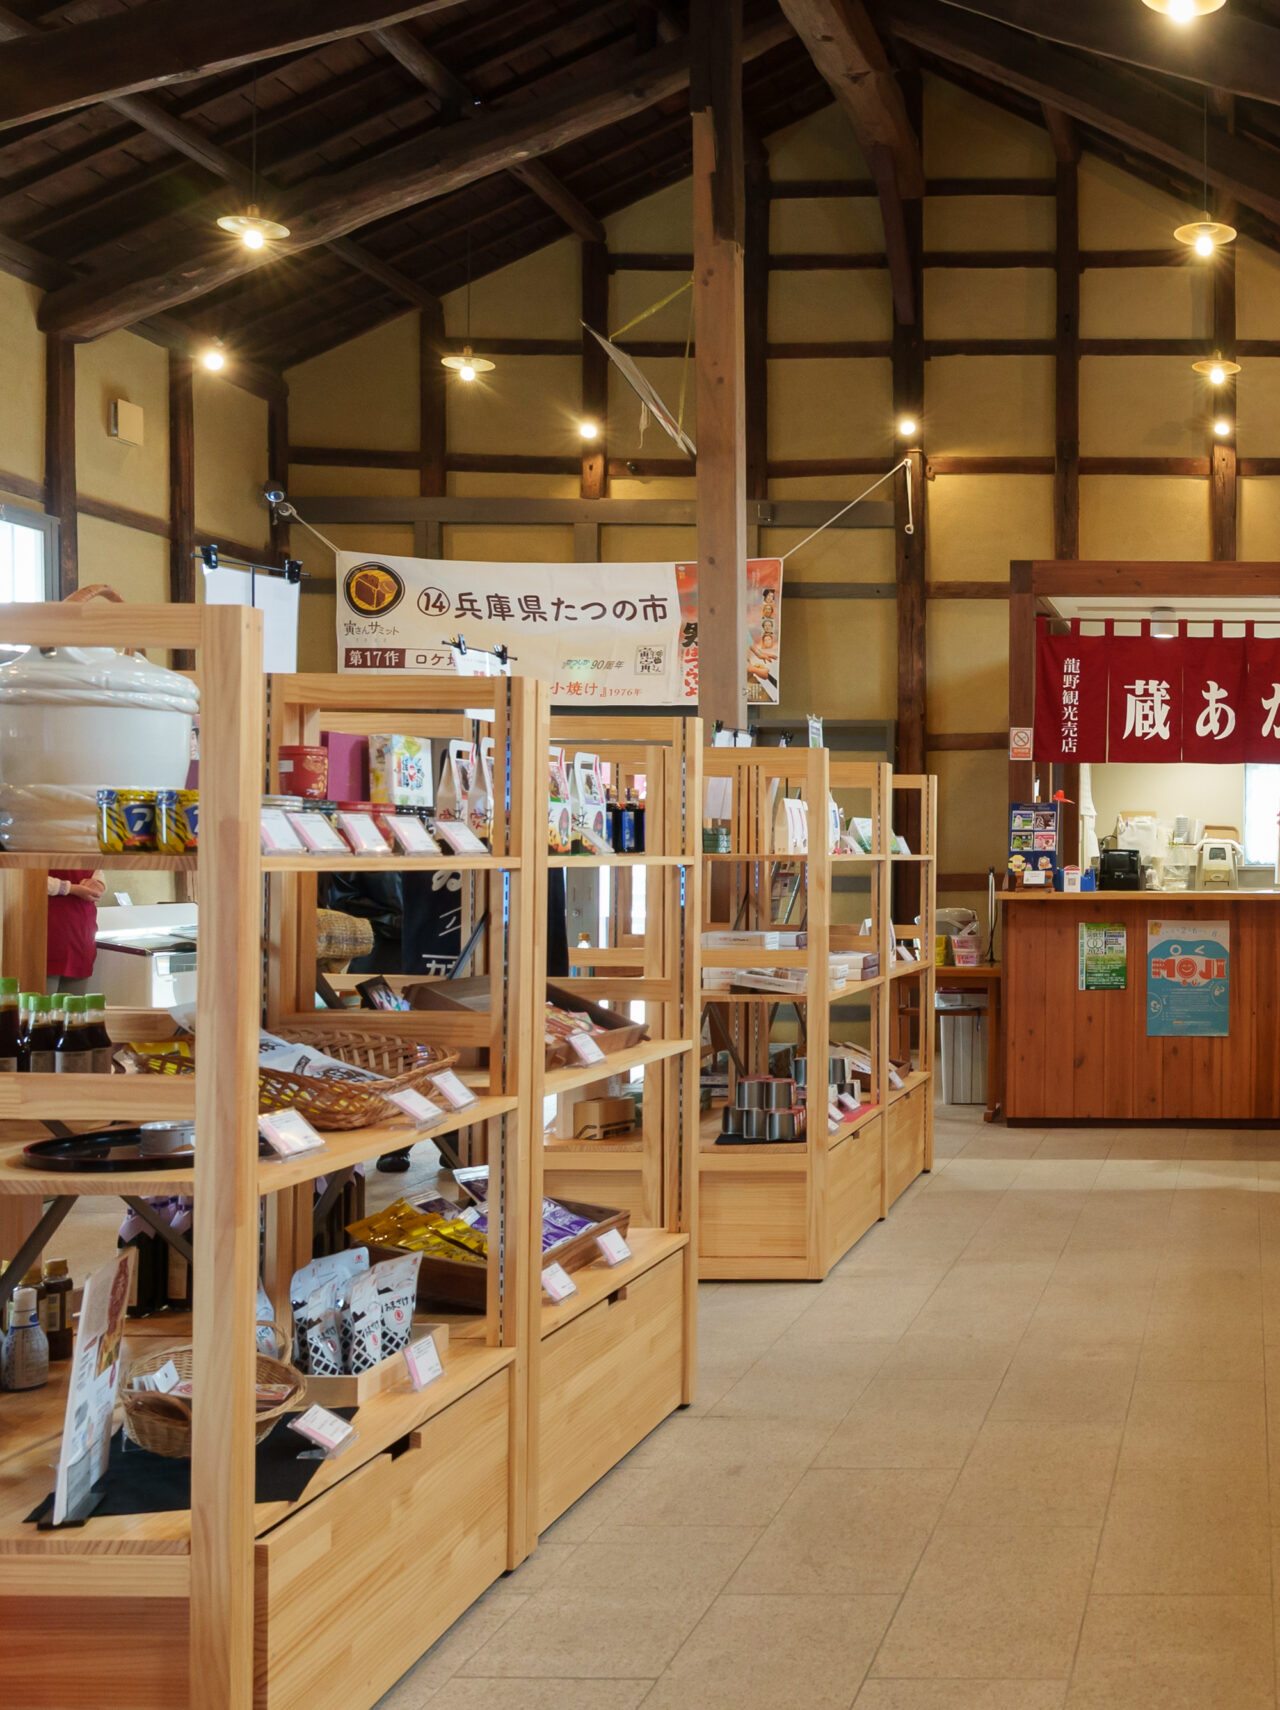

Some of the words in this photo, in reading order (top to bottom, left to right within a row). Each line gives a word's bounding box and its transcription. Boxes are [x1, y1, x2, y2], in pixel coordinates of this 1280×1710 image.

[454, 591, 668, 623] 兵庫県たつの市
[349, 650, 399, 667] 第17作
[1061, 657, 1080, 753] 龍野観光売店
